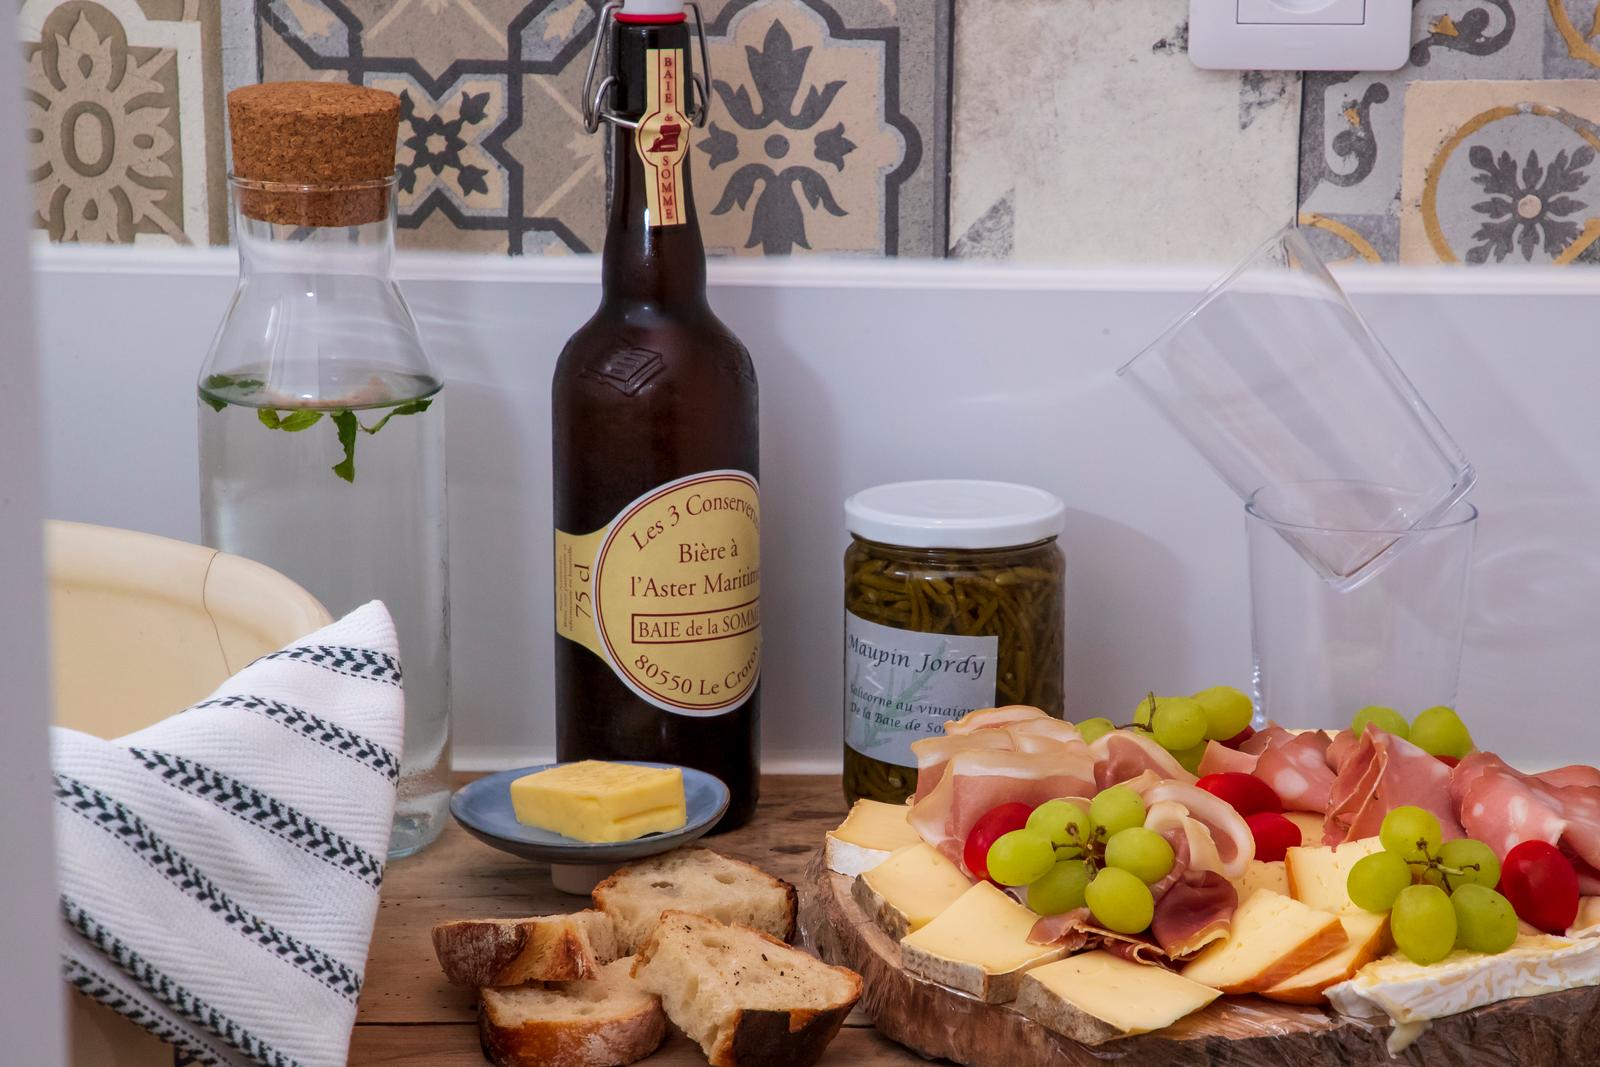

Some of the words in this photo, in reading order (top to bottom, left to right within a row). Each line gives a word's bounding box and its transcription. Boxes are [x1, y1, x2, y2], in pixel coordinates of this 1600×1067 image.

[664, 57, 673, 103] BAIE
[664, 113, 673, 122] de
[661, 156, 673, 219] SOMME
[630, 519, 664, 551] Les
[668, 505, 680, 527] 3
[679, 543, 725, 563] Bière
[731, 538, 738, 557] à
[574, 563, 589, 582] cl
[575, 591, 591, 618] 75
[639, 621, 681, 638] BAIE
[686, 620, 703, 636] de
[707, 617, 719, 634] la
[849, 634, 910, 668] Maupin
[916, 654, 986, 680] Jordy
[634, 655, 692, 695] 80550
[699, 679, 720, 696] Le
[850, 684, 892, 708] Salicorne
[896, 702, 913, 713] au
[850, 702, 860, 715] De
[863, 708, 871, 720] la
[875, 713, 901, 728] Baie
[905, 718, 921, 731] de
[925, 724, 947, 734] So
